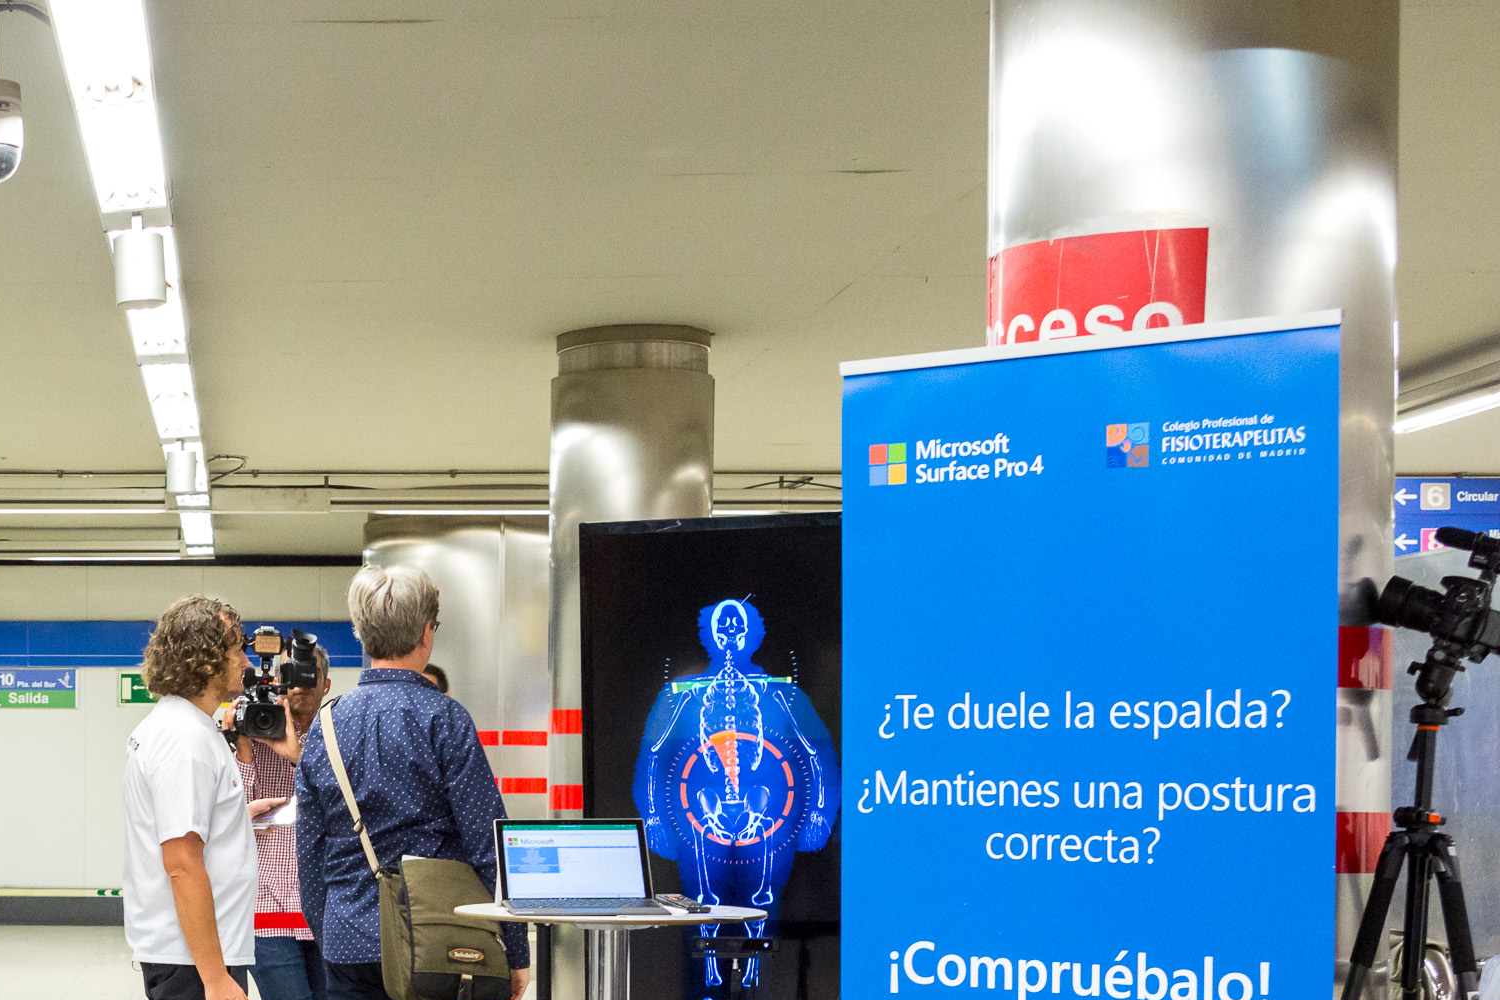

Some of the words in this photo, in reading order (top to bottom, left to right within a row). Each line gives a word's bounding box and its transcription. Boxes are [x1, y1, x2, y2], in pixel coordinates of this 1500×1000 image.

[1162, 420, 1200, 434] Colegio
[1202, 414, 1257, 430] Profesional
[1260, 413, 1275, 425] de
[915, 432, 1010, 461] Microsoft
[1161, 426, 1307, 453] FISIOTERAPEUTAS
[1161, 453, 1231, 465] COMUNIDAD
[1238, 451, 1252, 460] DE
[1259, 447, 1307, 458] MADRID
[915, 460, 990, 484] Surface
[994, 457, 1028, 478] Pro
[1029, 454, 1045, 475] 4
[1426, 485, 1445, 508] 6
[1456, 490, 1500, 502] Circular
[32, 680, 43, 688] del
[8, 692, 49, 704] Salida
[878, 693, 935, 739] ¿Te
[947, 690, 1050, 730] duele
[1064, 690, 1096, 730] la
[1108, 688, 1292, 740] espalda?
[856, 769, 1060, 814] ¿Mantienes
[1073, 779, 1144, 810] una
[1157, 775, 1317, 821] postura
[519, 837, 555, 846] Microsoft
[984, 827, 1162, 865] correcta?
